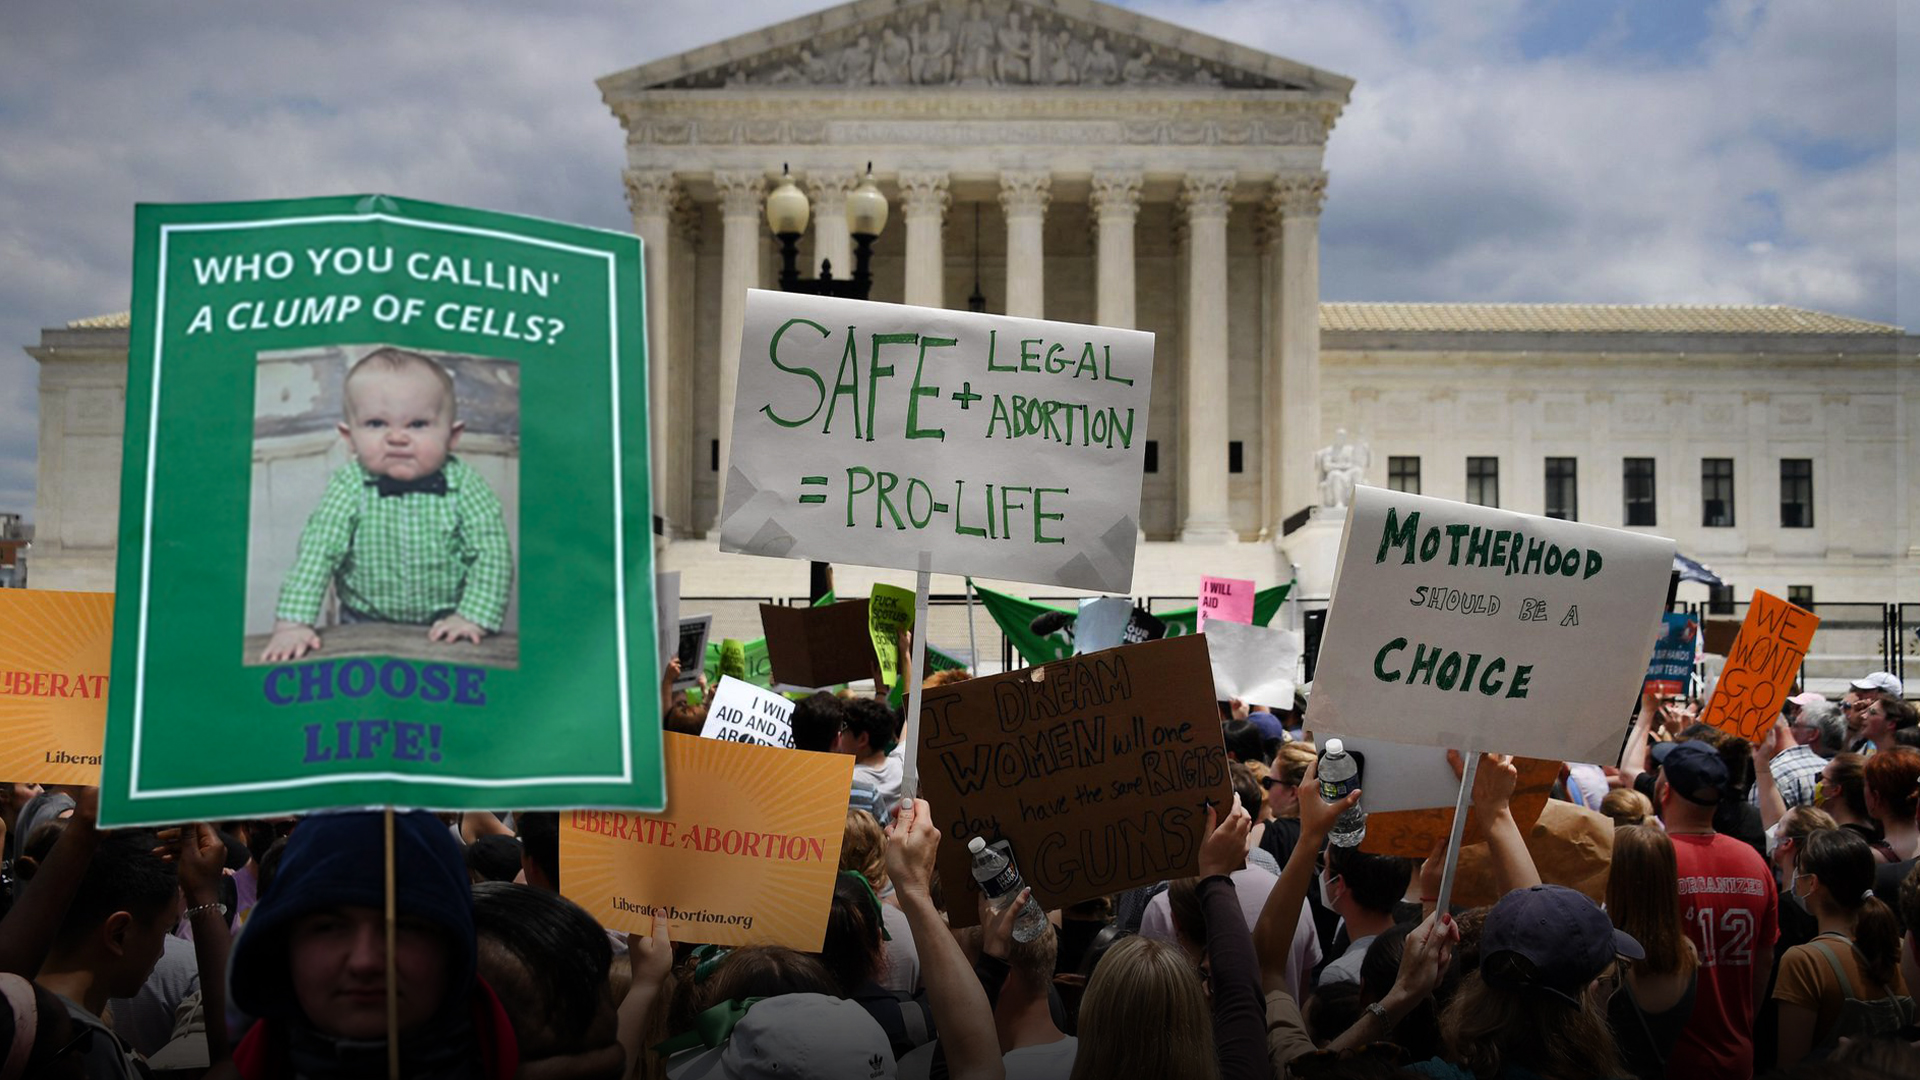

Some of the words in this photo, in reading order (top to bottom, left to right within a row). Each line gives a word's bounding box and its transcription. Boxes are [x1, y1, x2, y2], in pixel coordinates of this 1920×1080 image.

[192, 250, 296, 285] WHO
[306, 246, 394, 276] YOU
[406, 252, 561, 297] CALLIN'
[186, 304, 213, 336] A
[226, 294, 362, 331] CLUMP
[371, 293, 426, 326] OF
[433, 301, 566, 345] CELLS?
[759, 317, 959, 442] SAFE
[986, 329, 1135, 387] LEGAL
[986, 394, 1136, 449] ABORTION
[845, 465, 1070, 545] PRO-LIFE
[873, 594, 899, 608] FUCK
[1202, 596, 1219, 609] AID
[1203, 581, 1208, 593] I
[1209, 581, 1232, 596] WILL
[1409, 585, 1501, 616] SHOULD
[1518, 597, 1548, 622] BE
[1559, 604, 1579, 627] A
[872, 608, 908, 622] SCOTUS
[1756, 593, 1807, 646] WE
[262, 658, 489, 706] CHOOSE
[1373, 636, 1535, 699] CHOICE
[1734, 628, 1808, 685] WONT
[0, 671, 109, 699] LIBERAT
[751, 696, 759, 710] I
[921, 692, 968, 750] I
[993, 654, 1132, 733] DREAM
[1723, 668, 1776, 710] GO
[302, 718, 444, 764] LIFE!
[715, 705, 744, 725] AID
[745, 715, 777, 738] AND
[777, 730, 797, 750] AB
[1703, 690, 1777, 742] BACK
[45, 750, 102, 766] Liberat
[939, 715, 1106, 797] WOMEN
[1112, 716, 1147, 758] will
[1152, 720, 1194, 745] one
[951, 806, 1001, 841] day
[1017, 797, 1072, 824] have
[1074, 781, 1103, 807] the
[1109, 773, 1144, 800] same
[571, 809, 677, 848] LIBERATE
[680, 824, 827, 863] ABORTION
[1032, 805, 1194, 895] GUNS
[1677, 875, 1765, 897] ORGANIZER
